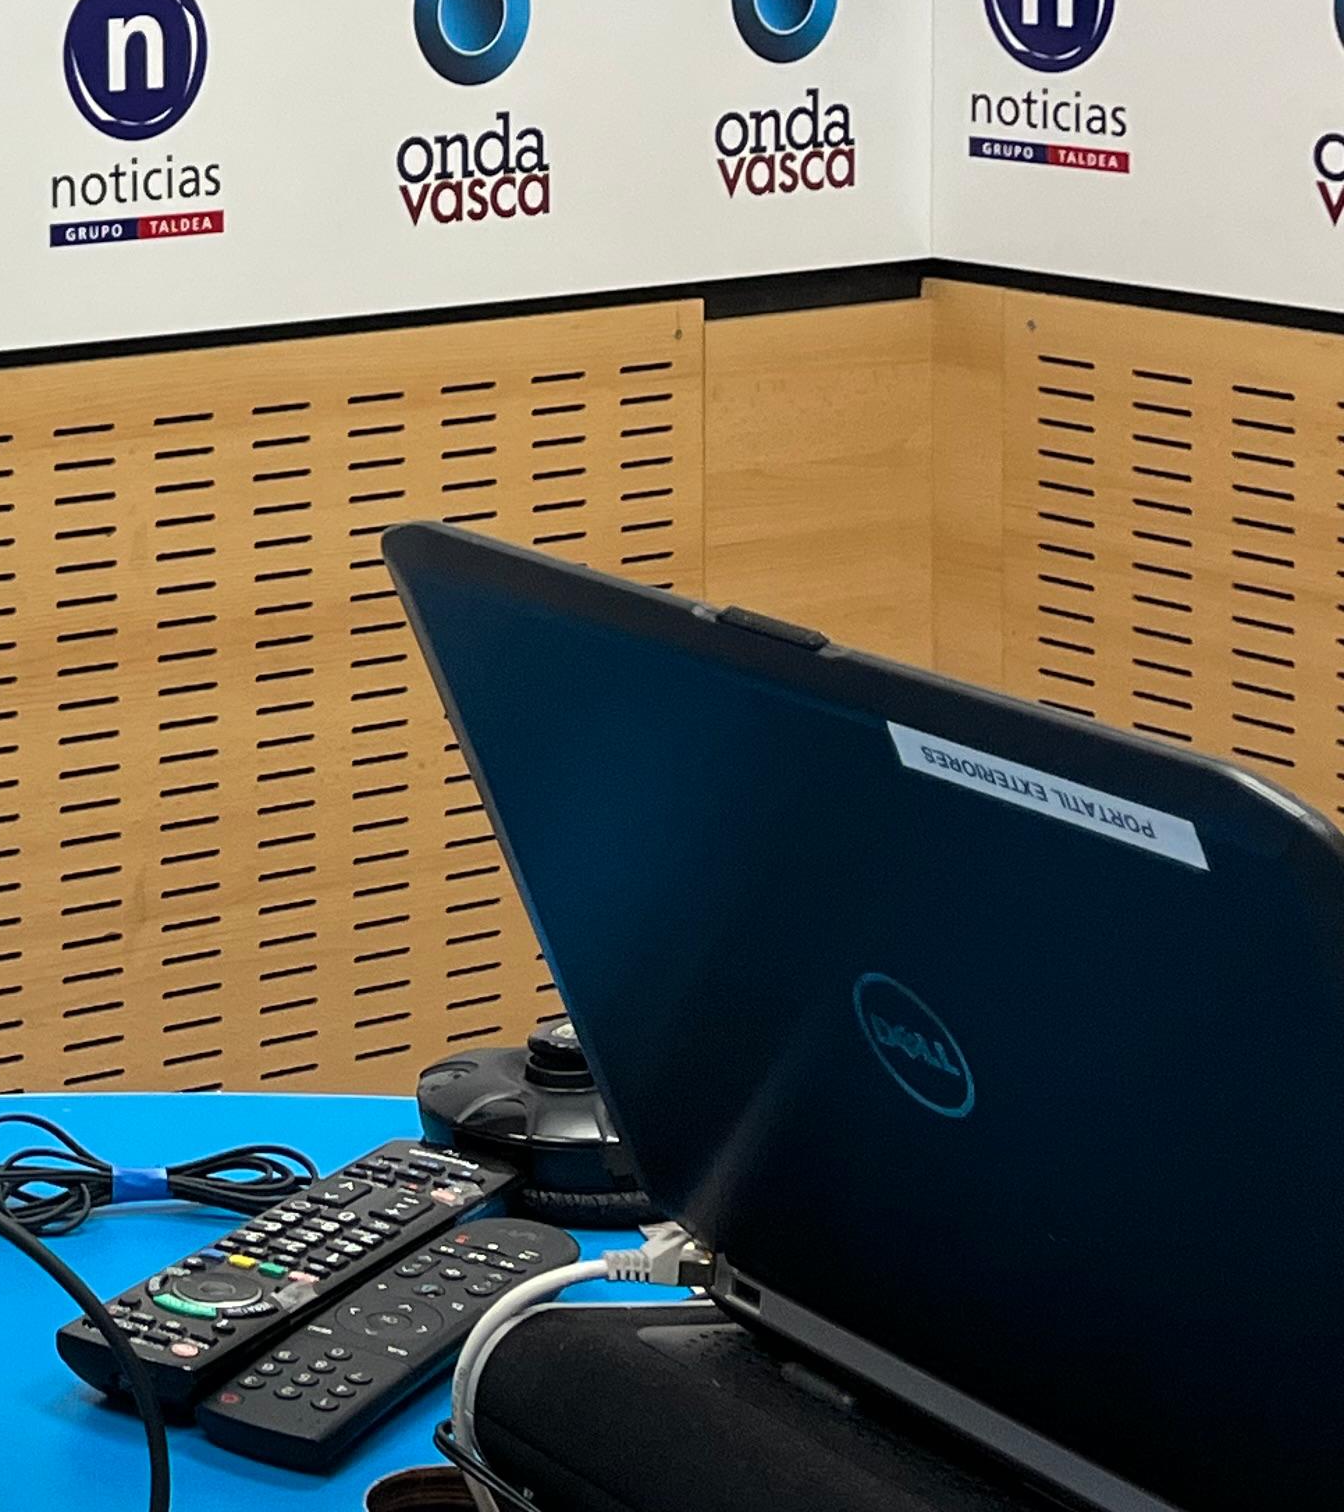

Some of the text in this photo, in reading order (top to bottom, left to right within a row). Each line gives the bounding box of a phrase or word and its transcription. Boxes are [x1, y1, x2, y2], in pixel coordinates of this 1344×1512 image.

[714, 88, 855, 157] onda
[968, 87, 1127, 137] noticias
[396, 111, 550, 182] onda
[717, 147, 855, 199] vasca
[981, 142, 1119, 168] GRUPO TALDEA
[51, 154, 221, 208] noticias
[399, 172, 550, 226] vasca
[65, 216, 213, 242] GRUPO TALDEA
[920, 745, 1158, 839] PORTATIL EXTERIORES
[869, 1012, 961, 1077] DELL
